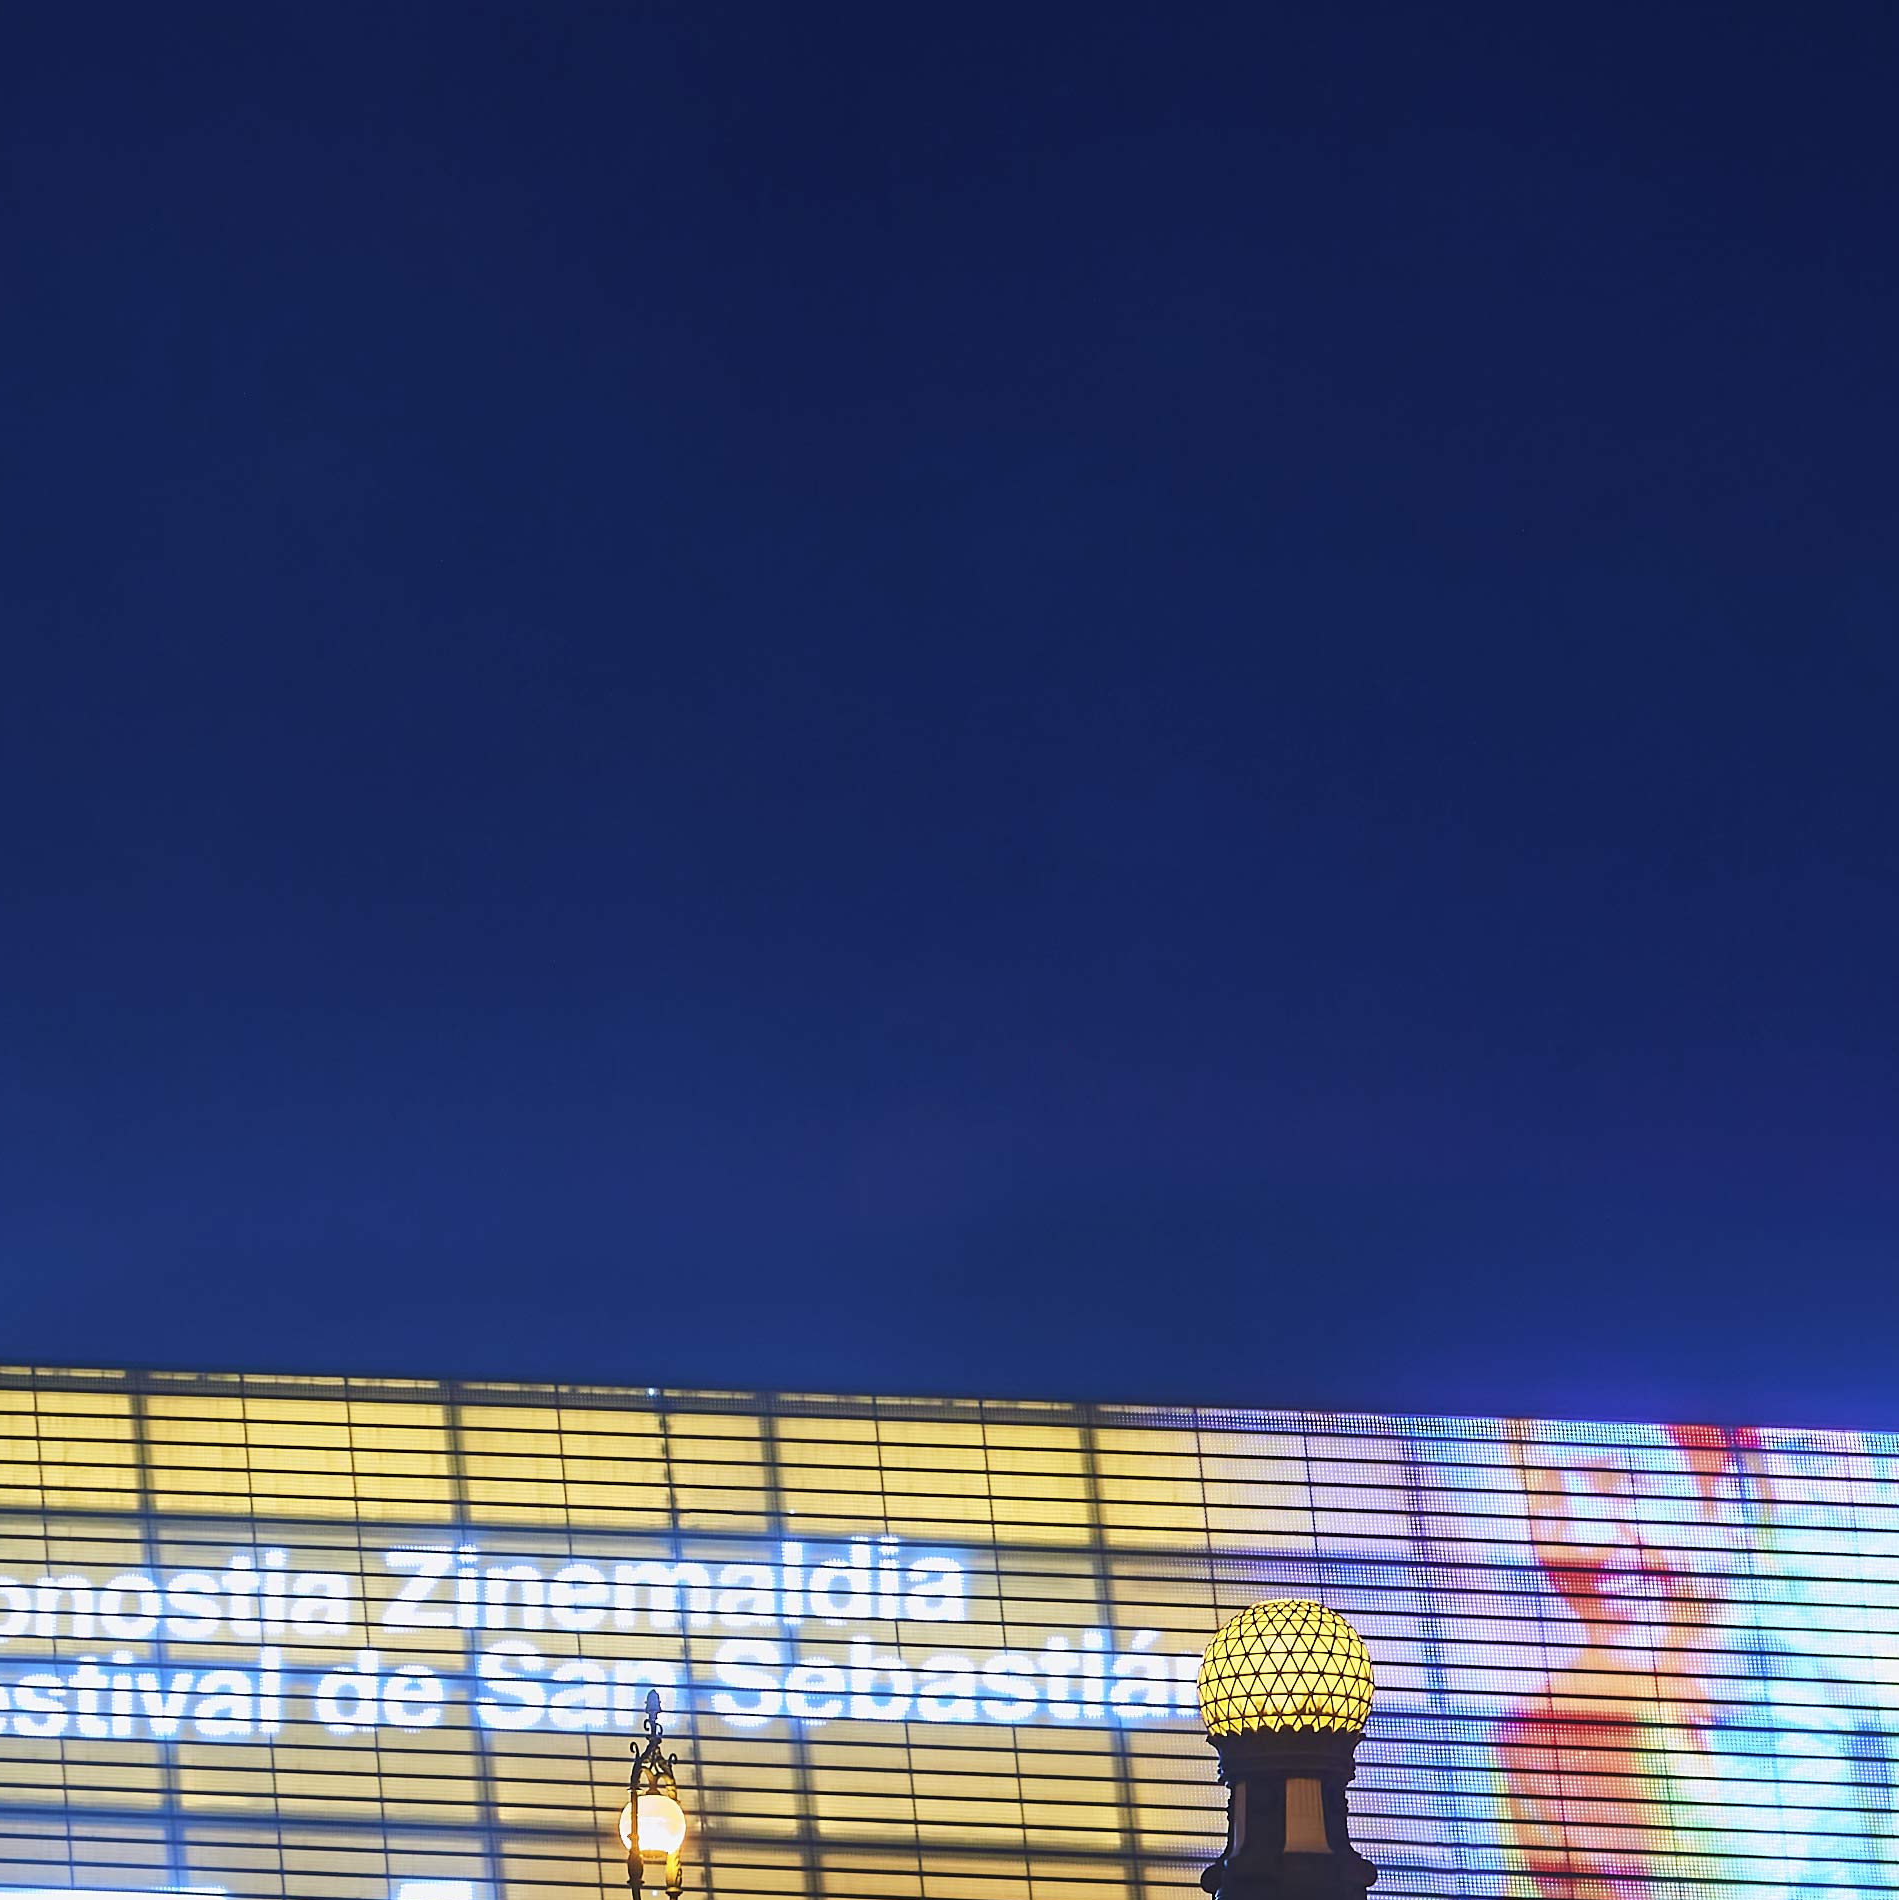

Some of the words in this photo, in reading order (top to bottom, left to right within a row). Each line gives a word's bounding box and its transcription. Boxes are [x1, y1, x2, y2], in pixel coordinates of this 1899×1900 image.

[384, 1537, 966, 1631] Zinemaldia
[316, 1650, 446, 1735] de
[476, 1640, 680, 1732] San
